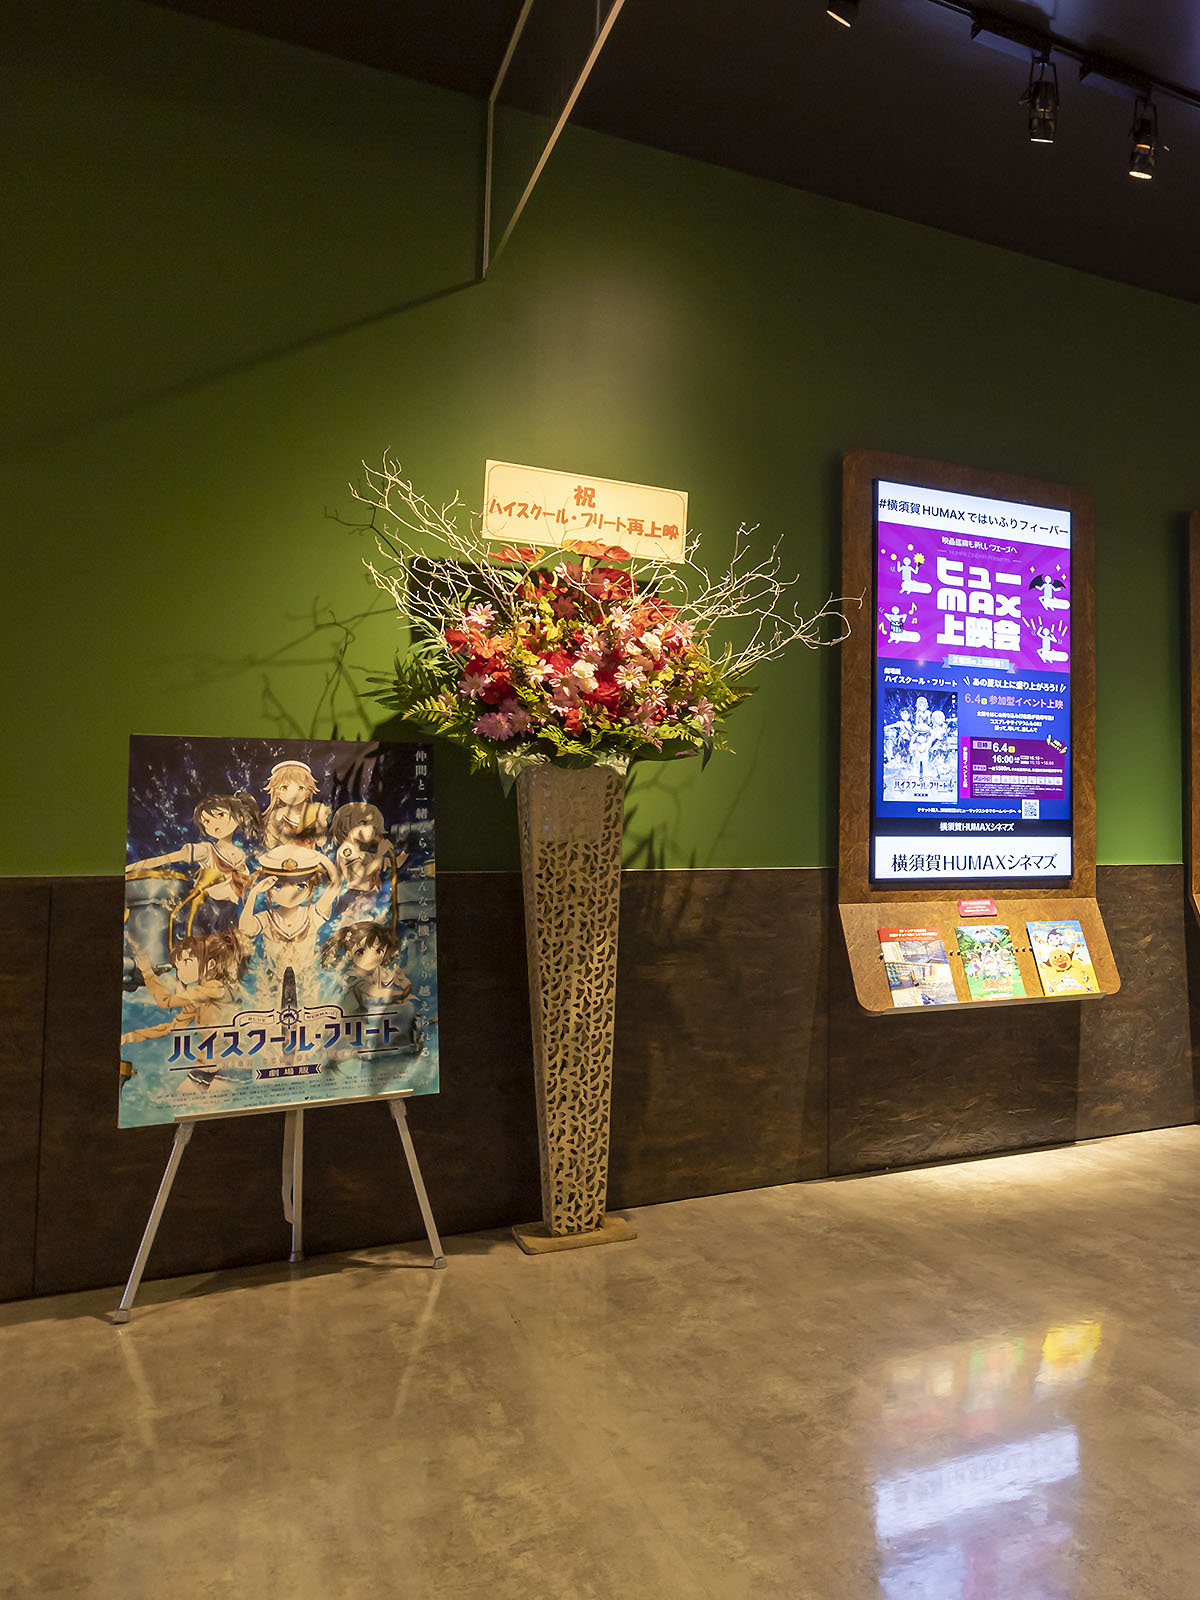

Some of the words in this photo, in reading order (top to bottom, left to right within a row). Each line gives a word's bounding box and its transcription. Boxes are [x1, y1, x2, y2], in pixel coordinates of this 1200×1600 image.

[574, 485, 596, 508] 祝
[488, 499, 680, 540] ハイスクール・フリート再上映
[936, 556, 1022, 590] ヒュー
[936, 587, 1022, 618] MAX
[936, 613, 1021, 651] 上映会
[891, 852, 1058, 872] 横須賀HUMAXシネマズ
[167, 1019, 399, 1063] ハイスクール・フリート
